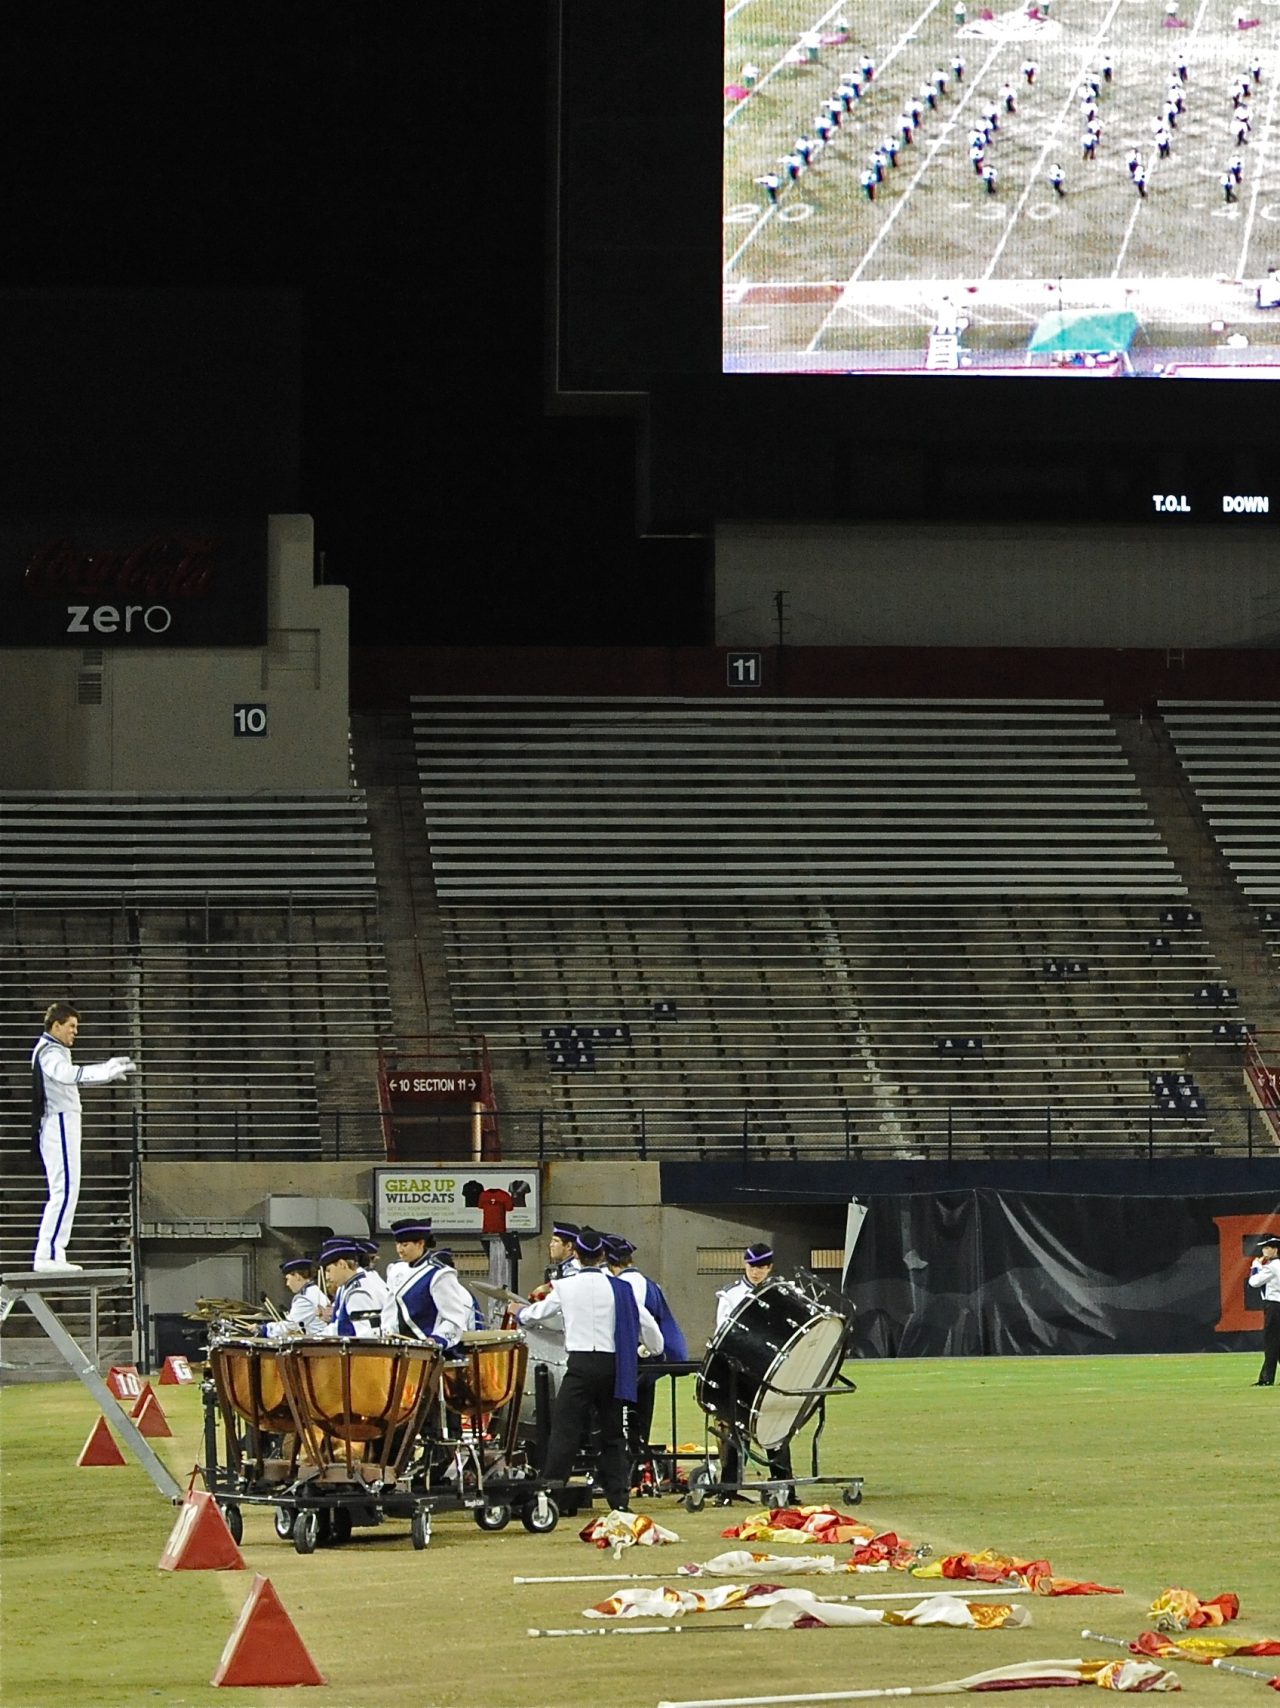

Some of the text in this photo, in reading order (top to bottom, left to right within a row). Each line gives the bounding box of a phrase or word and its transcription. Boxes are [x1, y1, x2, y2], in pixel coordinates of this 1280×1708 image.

[1152, 495, 1191, 512] T.O.L
[1222, 496, 1269, 513] DOWN
[66, 605, 172, 633] zero
[733, 659, 755, 681] 11
[234, 708, 266, 732] 10
[399, 1078, 467, 1092] 10 SECTION 11
[385, 1179, 456, 1192] GEAR UP
[386, 1193, 455, 1204] WILDCATS
[173, 1360, 193, 1380] G
[116, 1373, 140, 1396] 10
